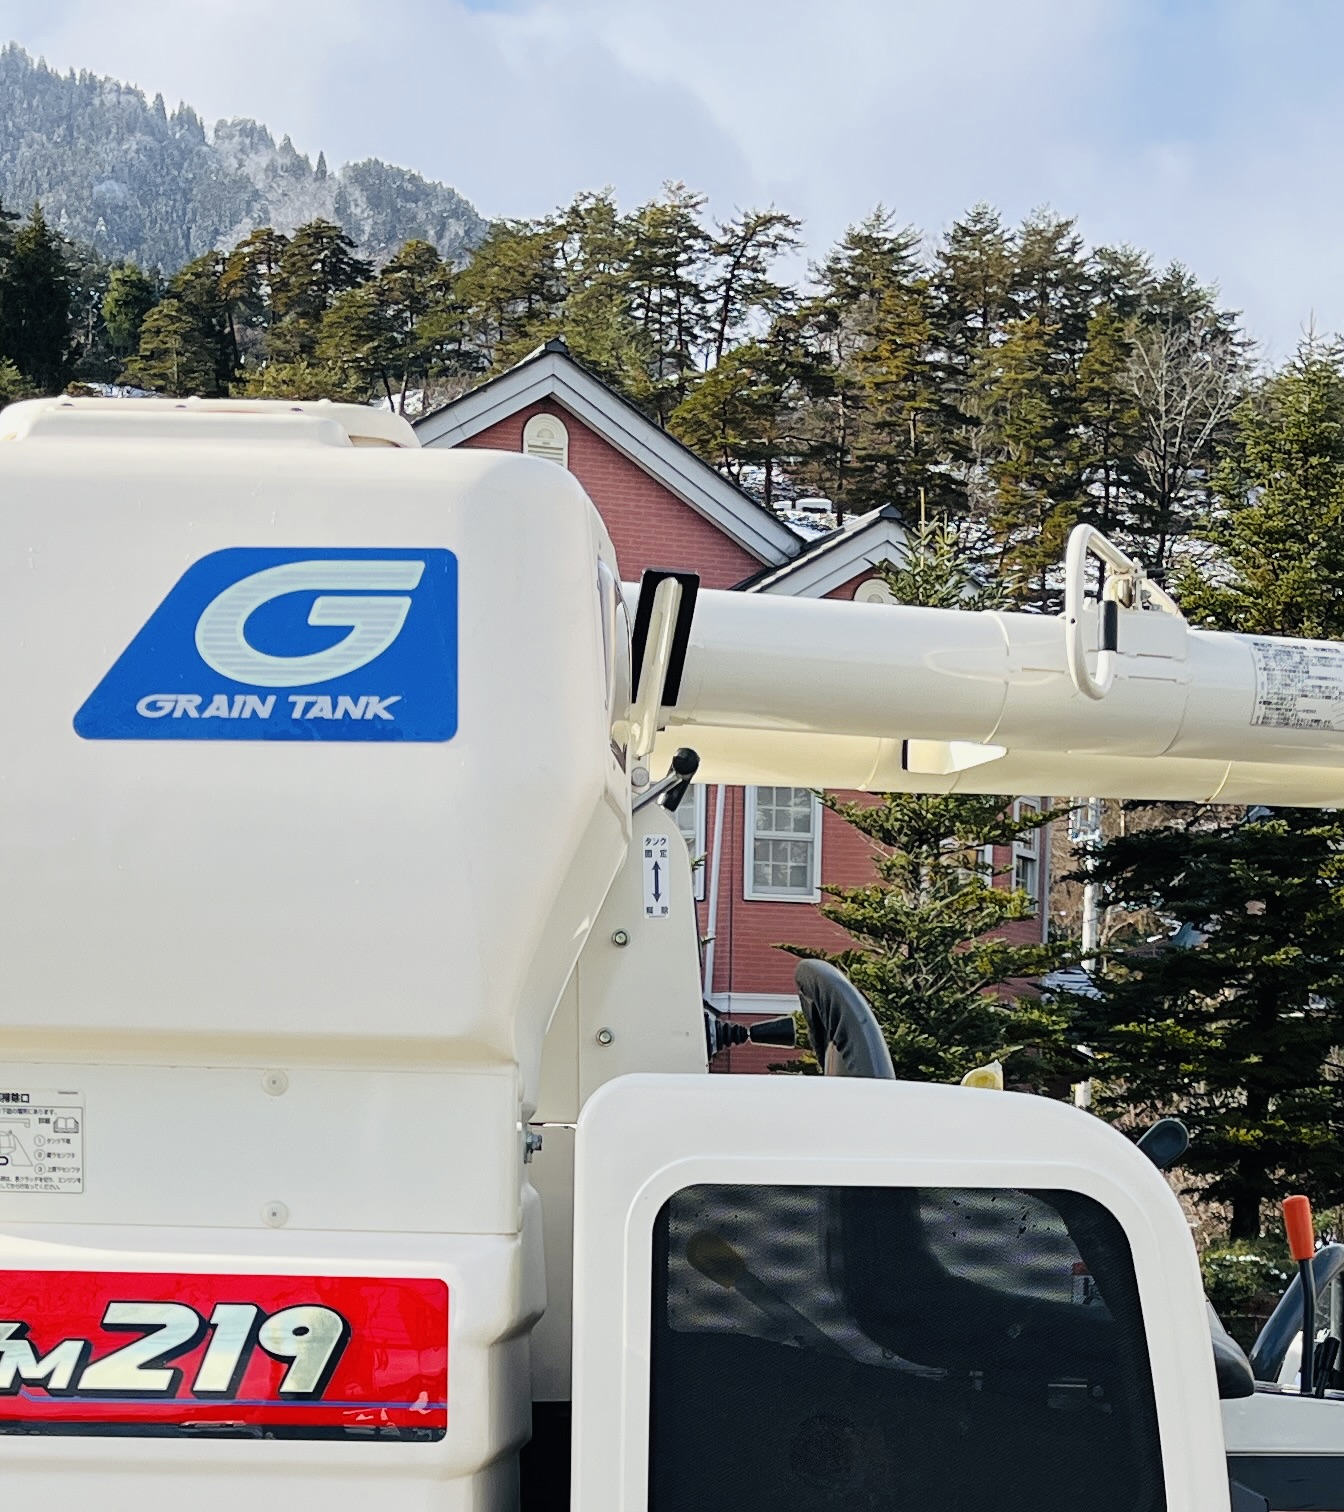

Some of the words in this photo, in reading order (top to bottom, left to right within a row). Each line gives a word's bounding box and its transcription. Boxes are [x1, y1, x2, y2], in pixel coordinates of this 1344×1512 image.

[136, 694, 277, 720] GRAIN
[288, 695, 402, 721] TANK
[645, 837, 667, 847] タンク
